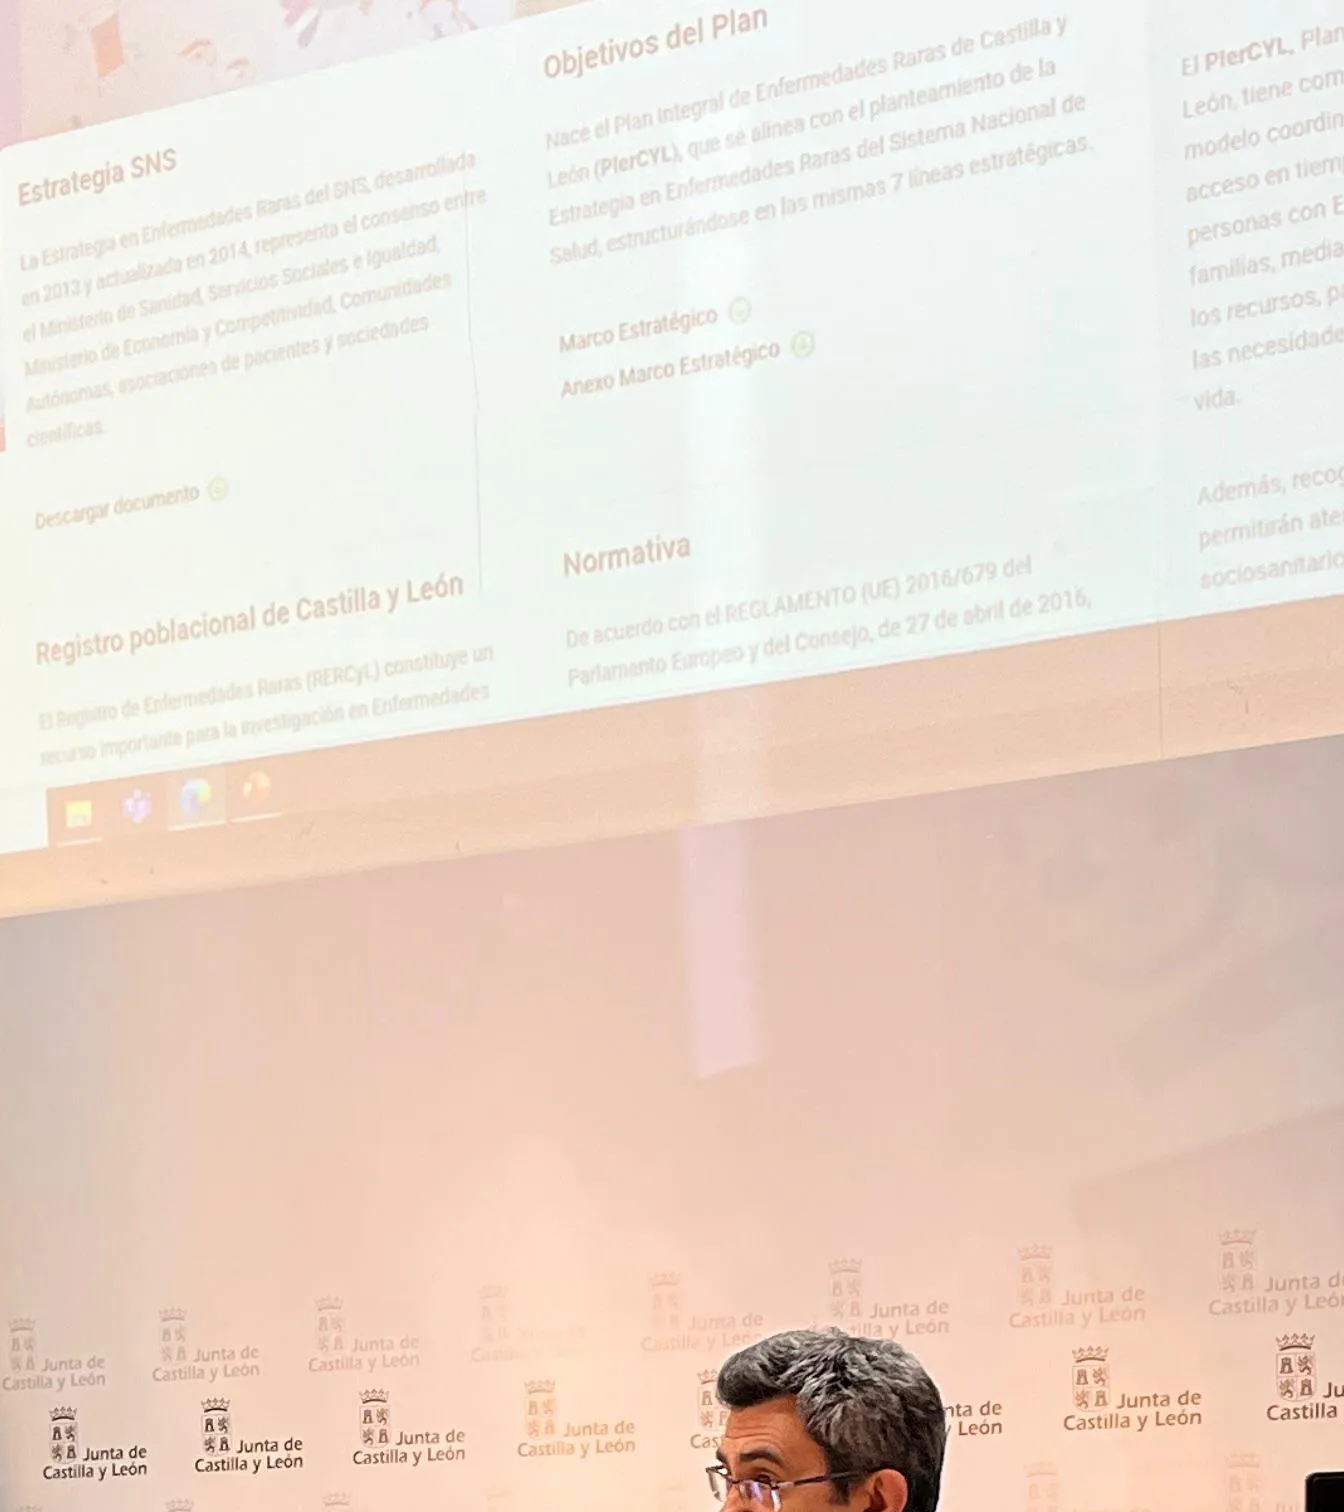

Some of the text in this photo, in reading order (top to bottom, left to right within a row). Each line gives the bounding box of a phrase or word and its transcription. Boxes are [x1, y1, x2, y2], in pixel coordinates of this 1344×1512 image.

[544, 8, 767, 79] Objetivos del Plan
[18, 147, 176, 207] Estrategia SNS
[559, 308, 718, 354] Marco Estratégico
[561, 342, 780, 399] Anexo Marco Estratégico
[35, 485, 200, 531] Descargar documento
[564, 536, 690, 578] Normativa
[36, 573, 463, 666] Registro poblacional de Castilla y León
[1117, 1390, 1202, 1410] Junta de
[1267, 1402, 1337, 1421] Castilla
[1063, 1408, 1202, 1433] Castilla y León
[237, 1436, 303, 1454] Junta de
[396, 1428, 465, 1446] Junta de
[83, 1445, 147, 1462] Junta de
[195, 1454, 303, 1474] Castilla y León
[353, 1446, 465, 1467] Castilla y León
[43, 1462, 147, 1482] Castilla y León
